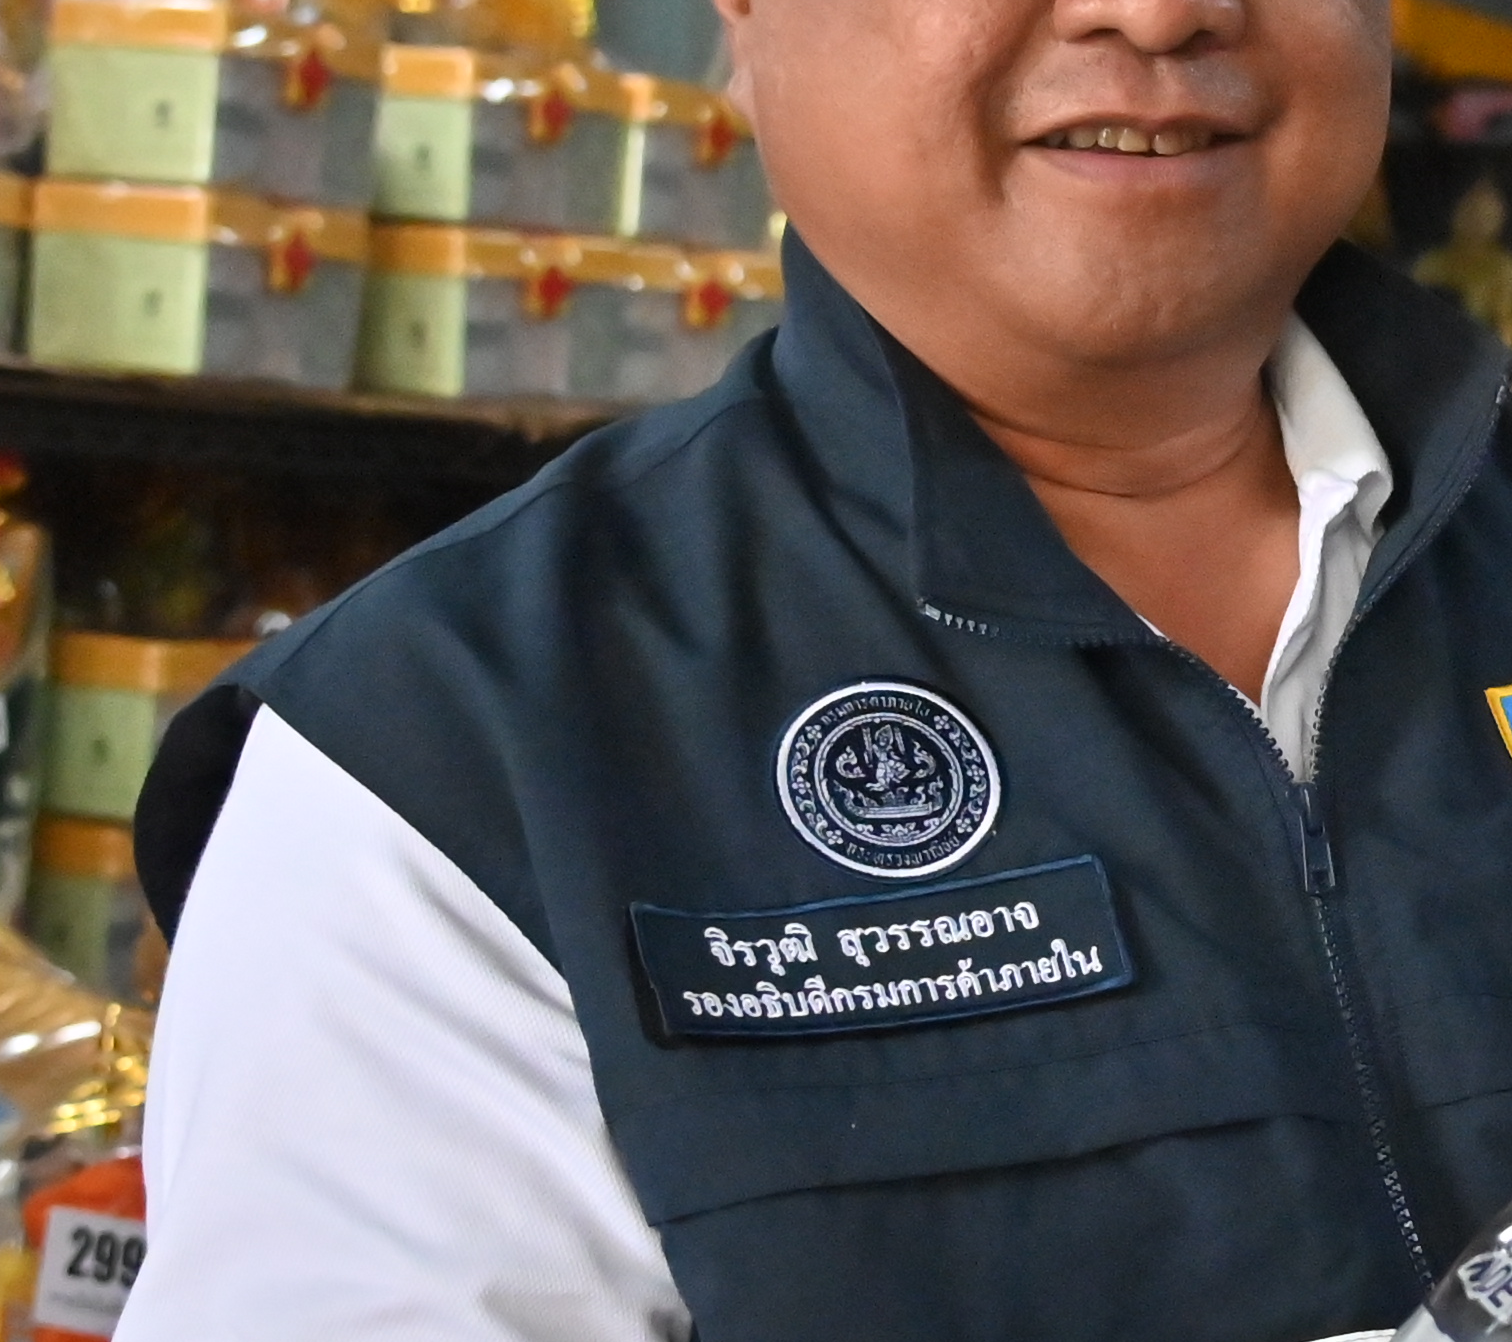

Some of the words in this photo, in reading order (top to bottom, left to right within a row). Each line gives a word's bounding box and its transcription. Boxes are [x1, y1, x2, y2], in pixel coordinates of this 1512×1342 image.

[704, 922, 819, 977] จิรวุฒิ
[836, 899, 1041, 968] สุวรรณอาจ
[683, 938, 1104, 1019] รองอธิบดีกรมการค้าภายใน
[67, 1224, 146, 1289] 299
